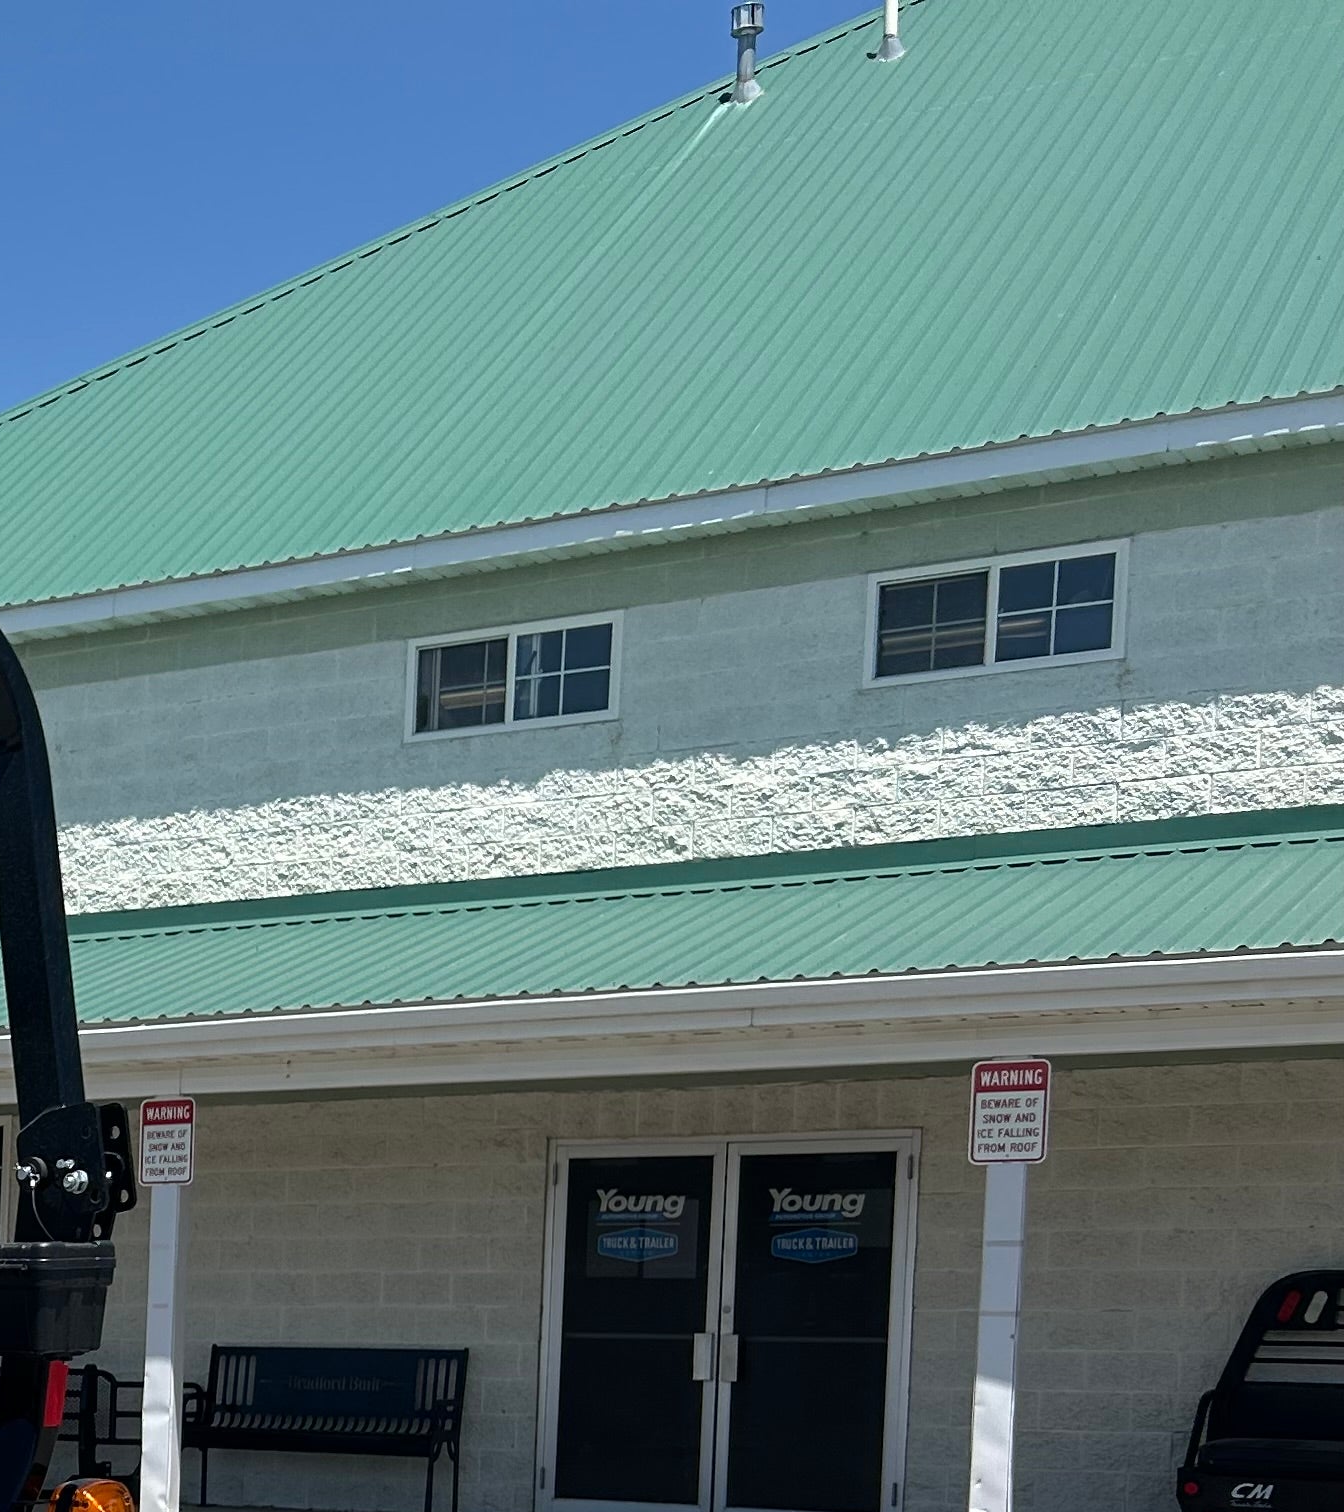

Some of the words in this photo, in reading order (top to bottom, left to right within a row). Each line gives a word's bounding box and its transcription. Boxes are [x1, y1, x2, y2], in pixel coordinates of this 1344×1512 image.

[980, 1068, 1043, 1087] WARNING
[980, 1098, 1022, 1109] BEWARE
[1025, 1097, 1040, 1108] OF
[146, 1105, 191, 1121] WARNING
[982, 1113, 1012, 1124] SNOW
[1014, 1112, 1036, 1123] AND
[146, 1129, 175, 1140] BEWARE
[177, 1128, 188, 1138] OF
[977, 1128, 994, 1139] ICE
[997, 1127, 1040, 1138] FALLING
[148, 1143, 169, 1152] SNOW
[170, 1142, 186, 1151] AND
[977, 1142, 1006, 1153] FROM
[1009, 1141, 1039, 1153] ROOF
[144, 1155, 157, 1164] ICE
[159, 1154, 188, 1164] FALLING
[145, 1167, 165, 1177] FROM
[168, 1166, 188, 1176] ROOF
[596, 1188, 686, 1219] Young
[768, 1188, 866, 1218] Young
[603, 1237, 629, 1249] TRUCK
[639, 1236, 675, 1249] TRAILER
[776, 1238, 805, 1250] TRUCK
[815, 1237, 854, 1250] TRAILER
[1230, 1482, 1274, 1499] CM
